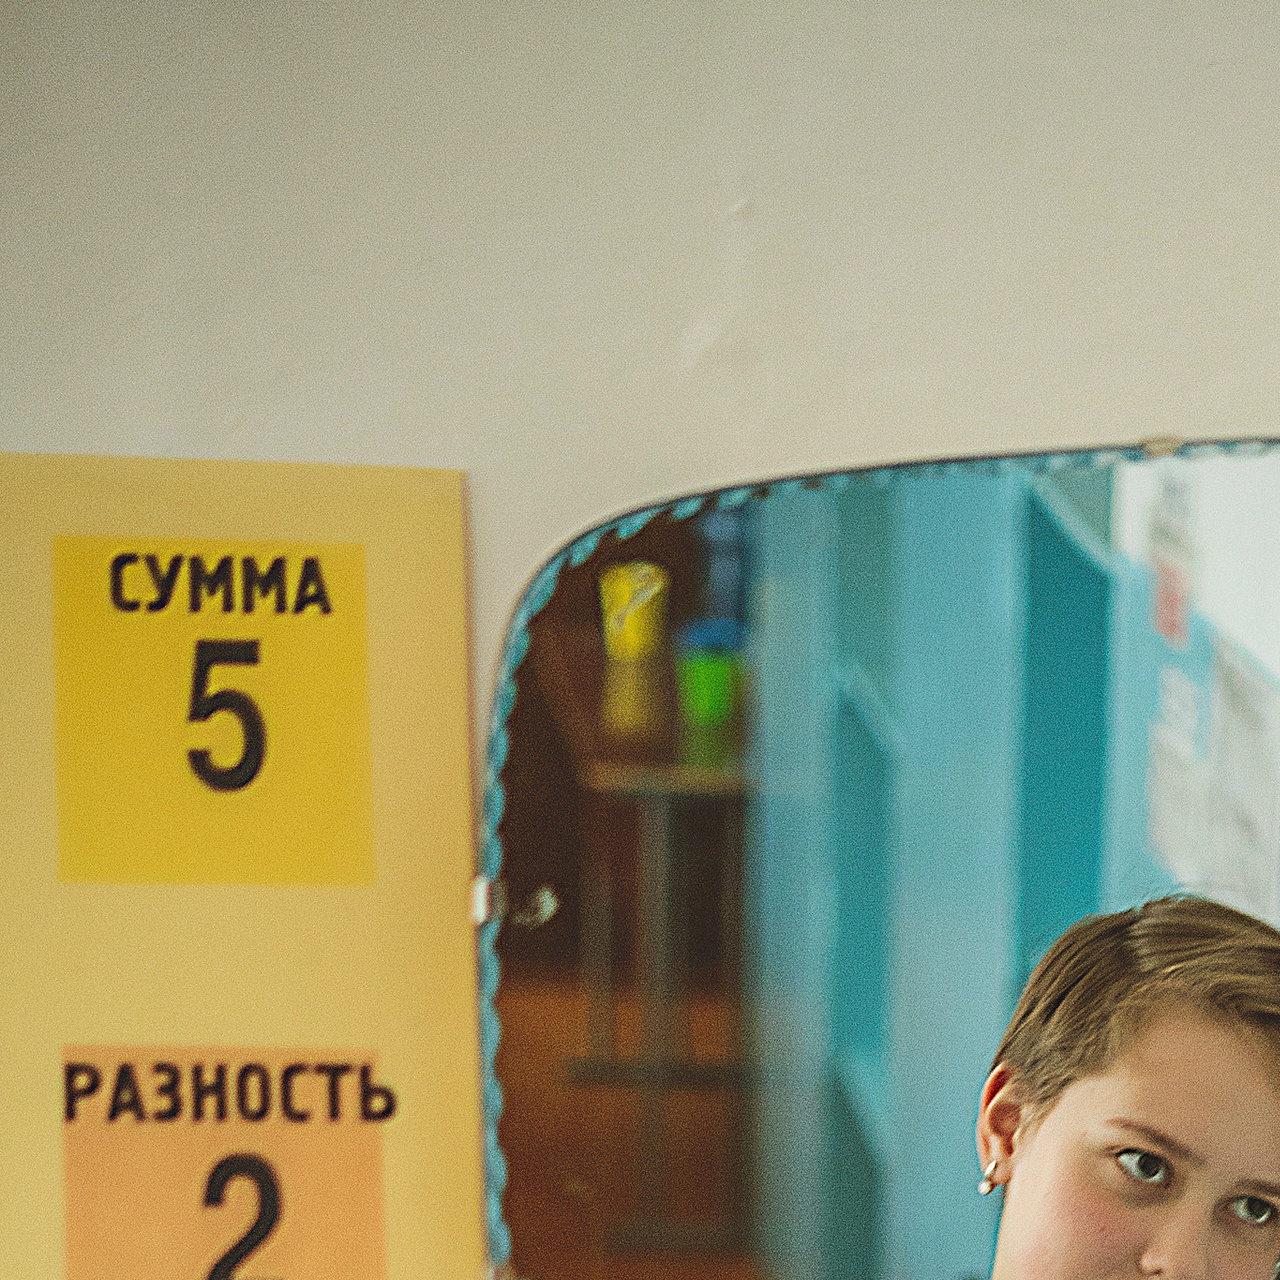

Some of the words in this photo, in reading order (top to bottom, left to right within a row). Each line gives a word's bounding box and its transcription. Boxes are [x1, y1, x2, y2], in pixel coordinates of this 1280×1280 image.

[108, 551, 333, 615] СУММА
[185, 638, 268, 793] 5
[62, 1060, 399, 1124] РАЗНОСТЬ
